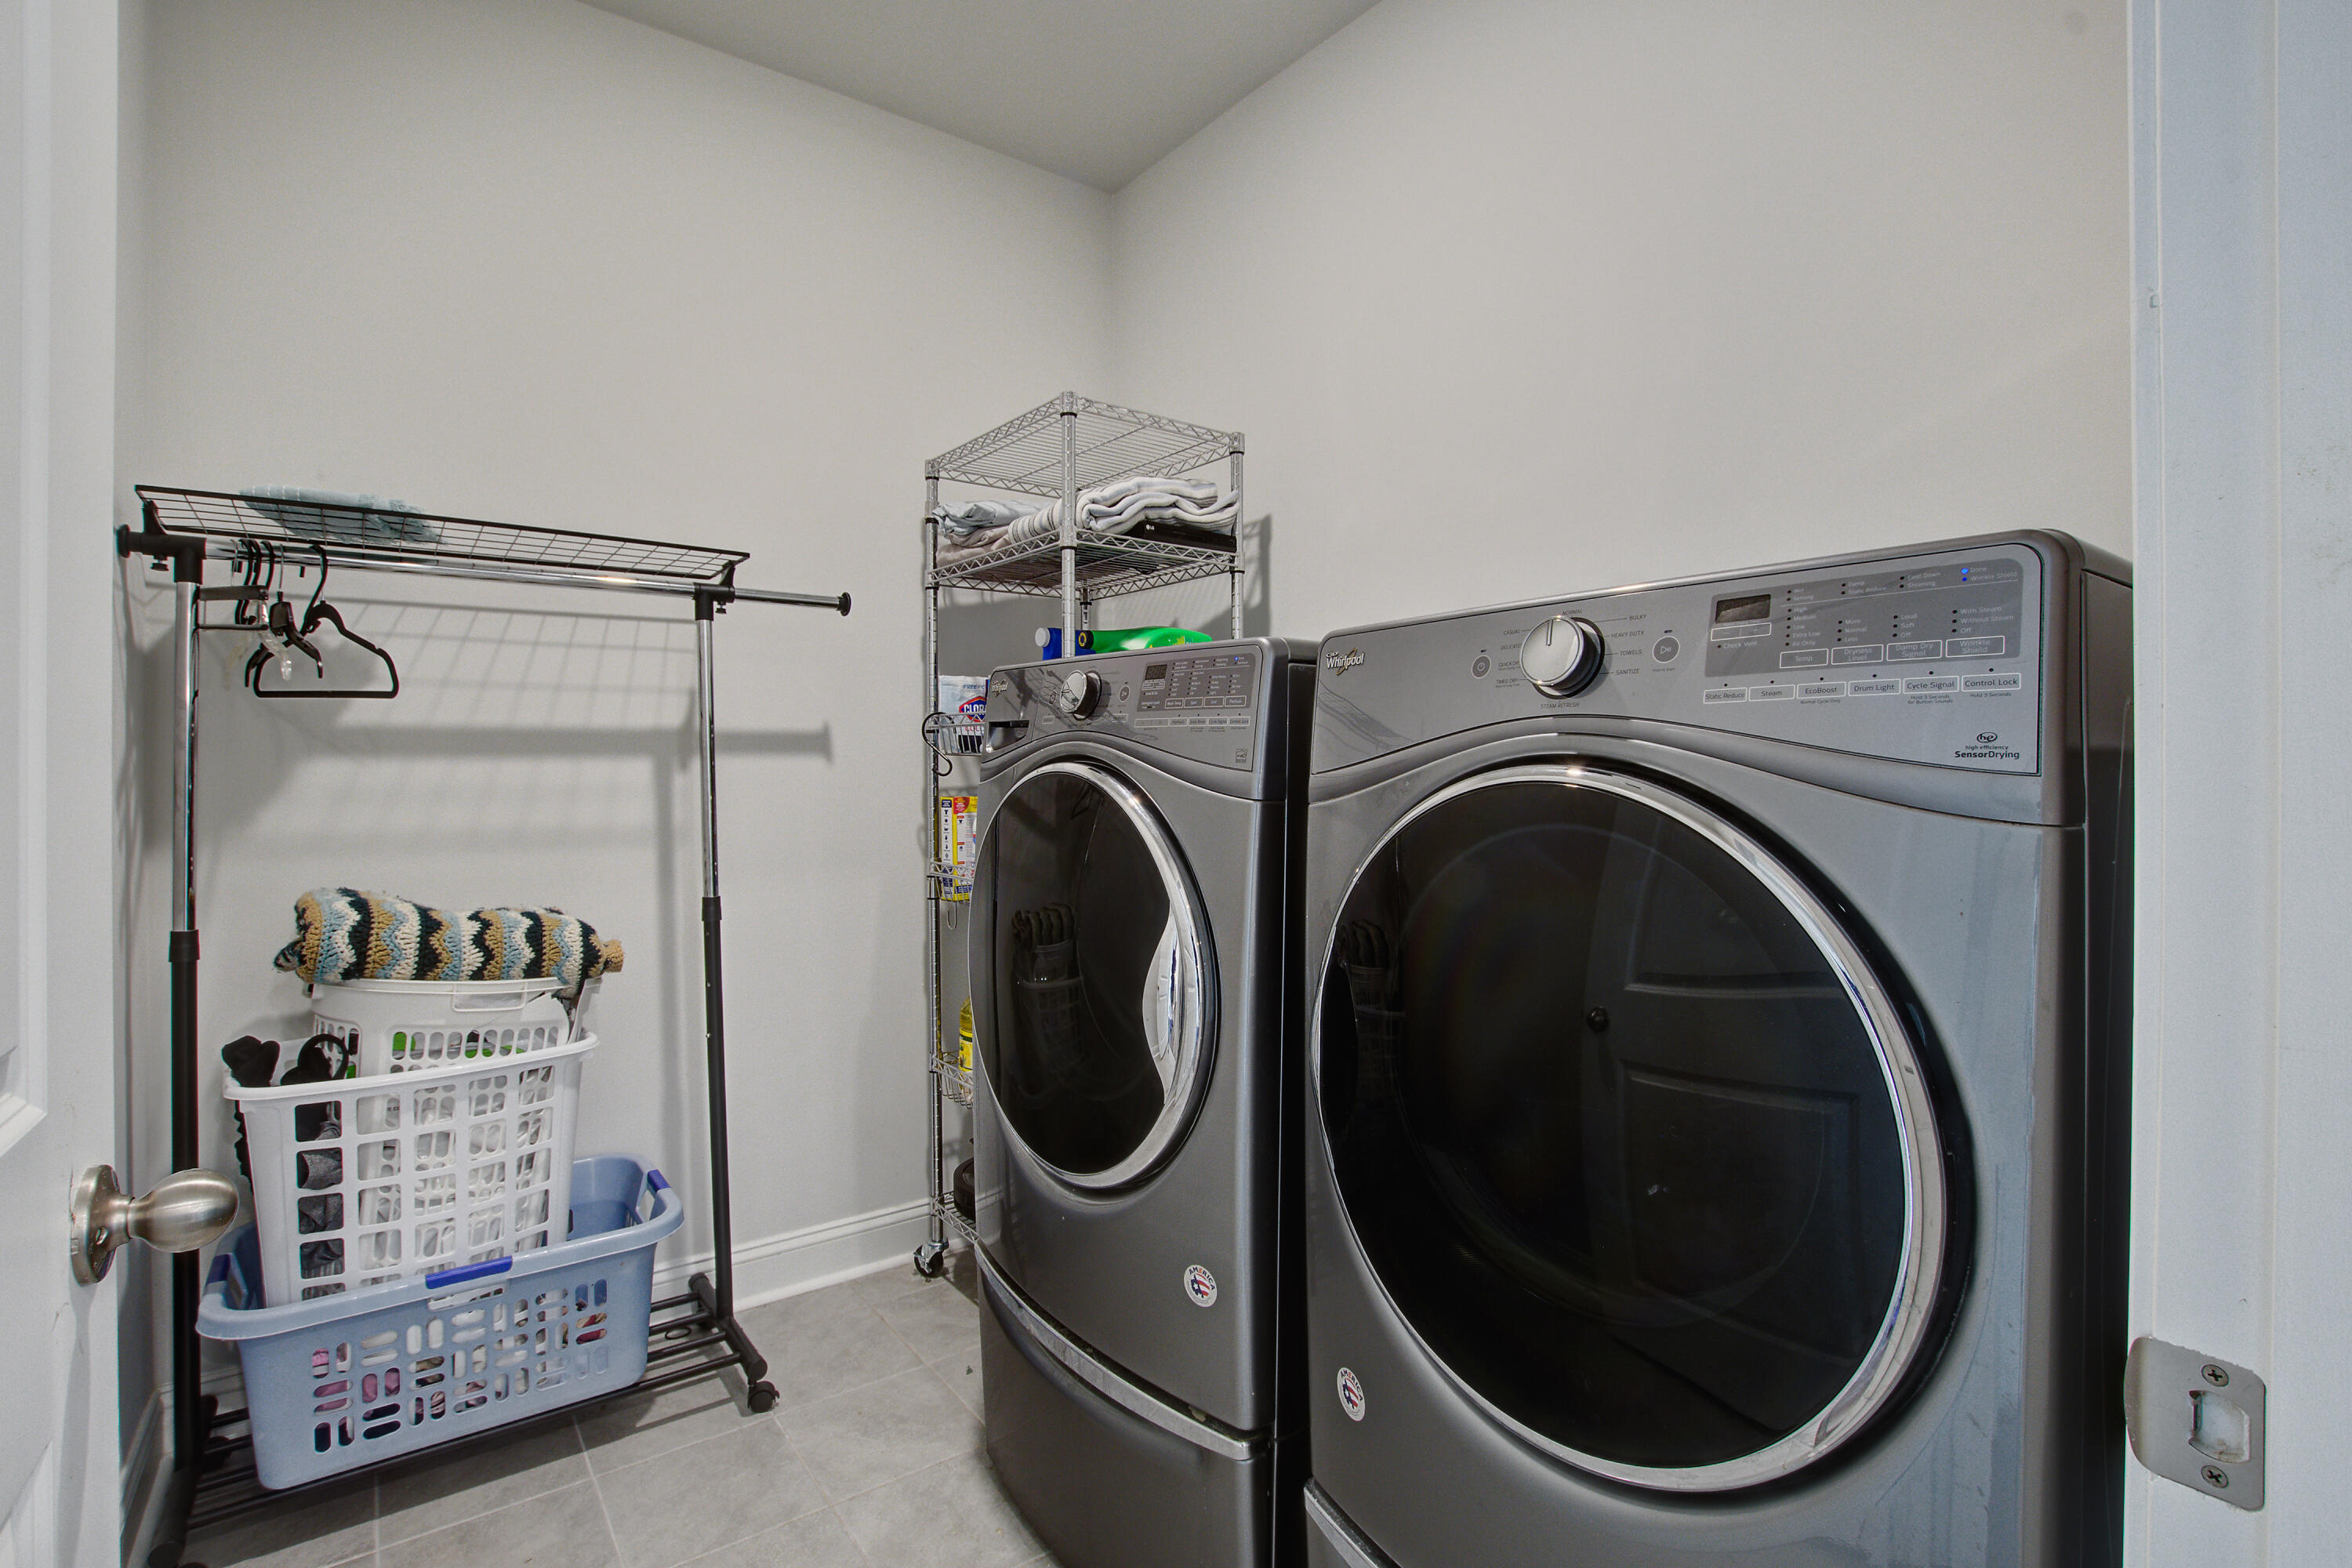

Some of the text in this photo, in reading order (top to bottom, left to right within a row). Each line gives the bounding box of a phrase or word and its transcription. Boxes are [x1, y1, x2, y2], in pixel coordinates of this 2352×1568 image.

[1895, 641, 1934, 652] Damp Dry
[1959, 639, 1991, 648] Wrinkle
[1620, 648, 1643, 657] TOWELS
[1843, 648, 1873, 656] Dryness
[1901, 650, 1926, 659] Signal
[1962, 646, 1988, 655] Shield
[1326, 651, 1365, 670] Whirlpool
[1615, 667, 1640, 676] SANITIZE
[1907, 680, 1955, 690] Cycle Signal
[1964, 677, 2018, 688] Control Lock
[1805, 686, 1837, 695] EcoBoost
[1875, 684, 1896, 692] Light
[964, 703, 985, 716] CLOR
[1954, 750, 2020, 760] SensorDrying
[1189, 1266, 1216, 1291] AMERICA
[1340, 1368, 1363, 1403] AMERICA
